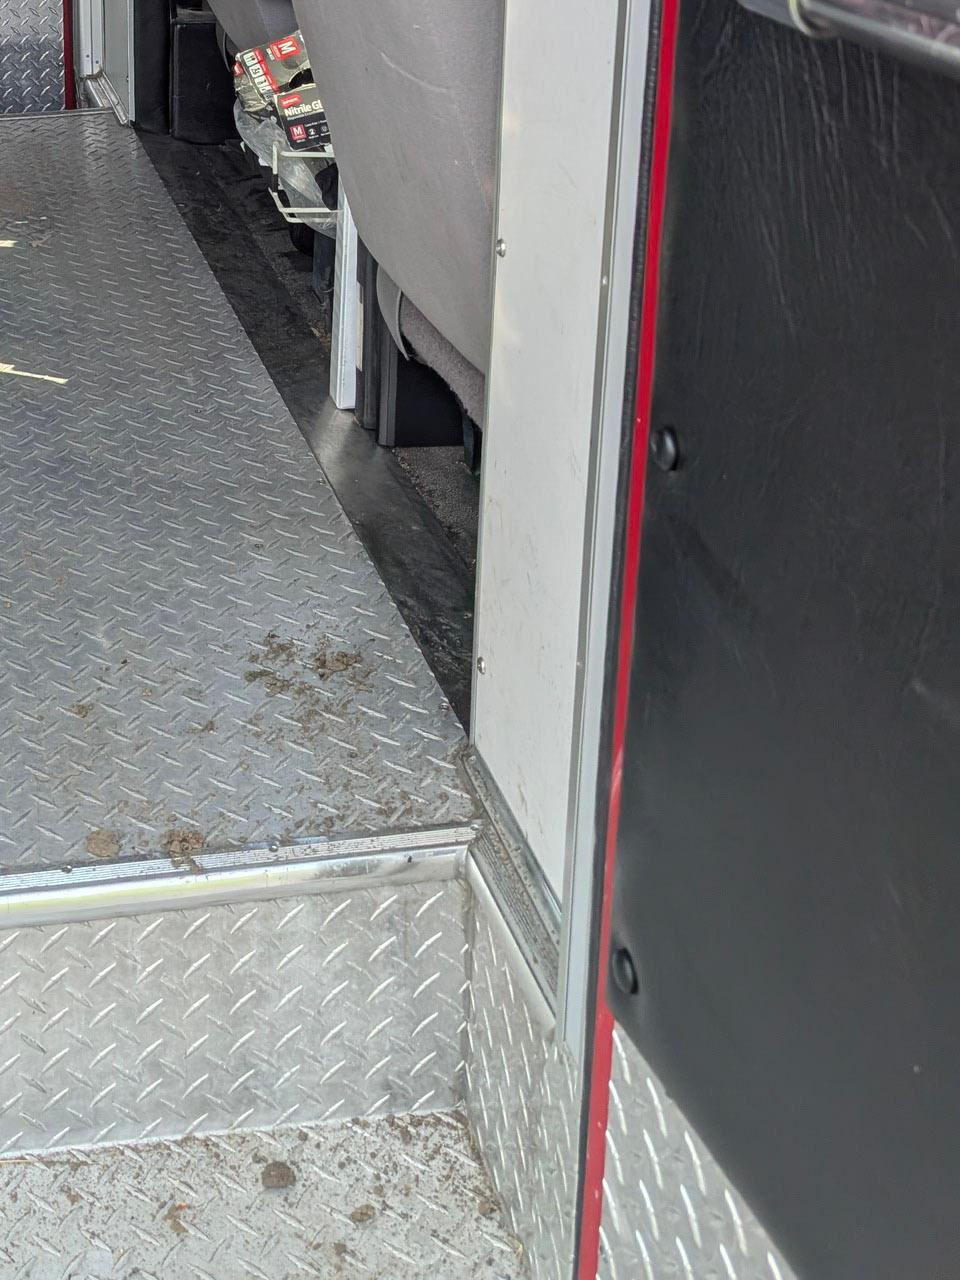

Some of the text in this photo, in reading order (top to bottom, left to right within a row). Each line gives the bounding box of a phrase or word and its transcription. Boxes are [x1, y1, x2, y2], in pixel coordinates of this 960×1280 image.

[278, 41, 296, 55] M
[284, 103, 312, 117] Nitrile
[293, 126, 303, 136] M
